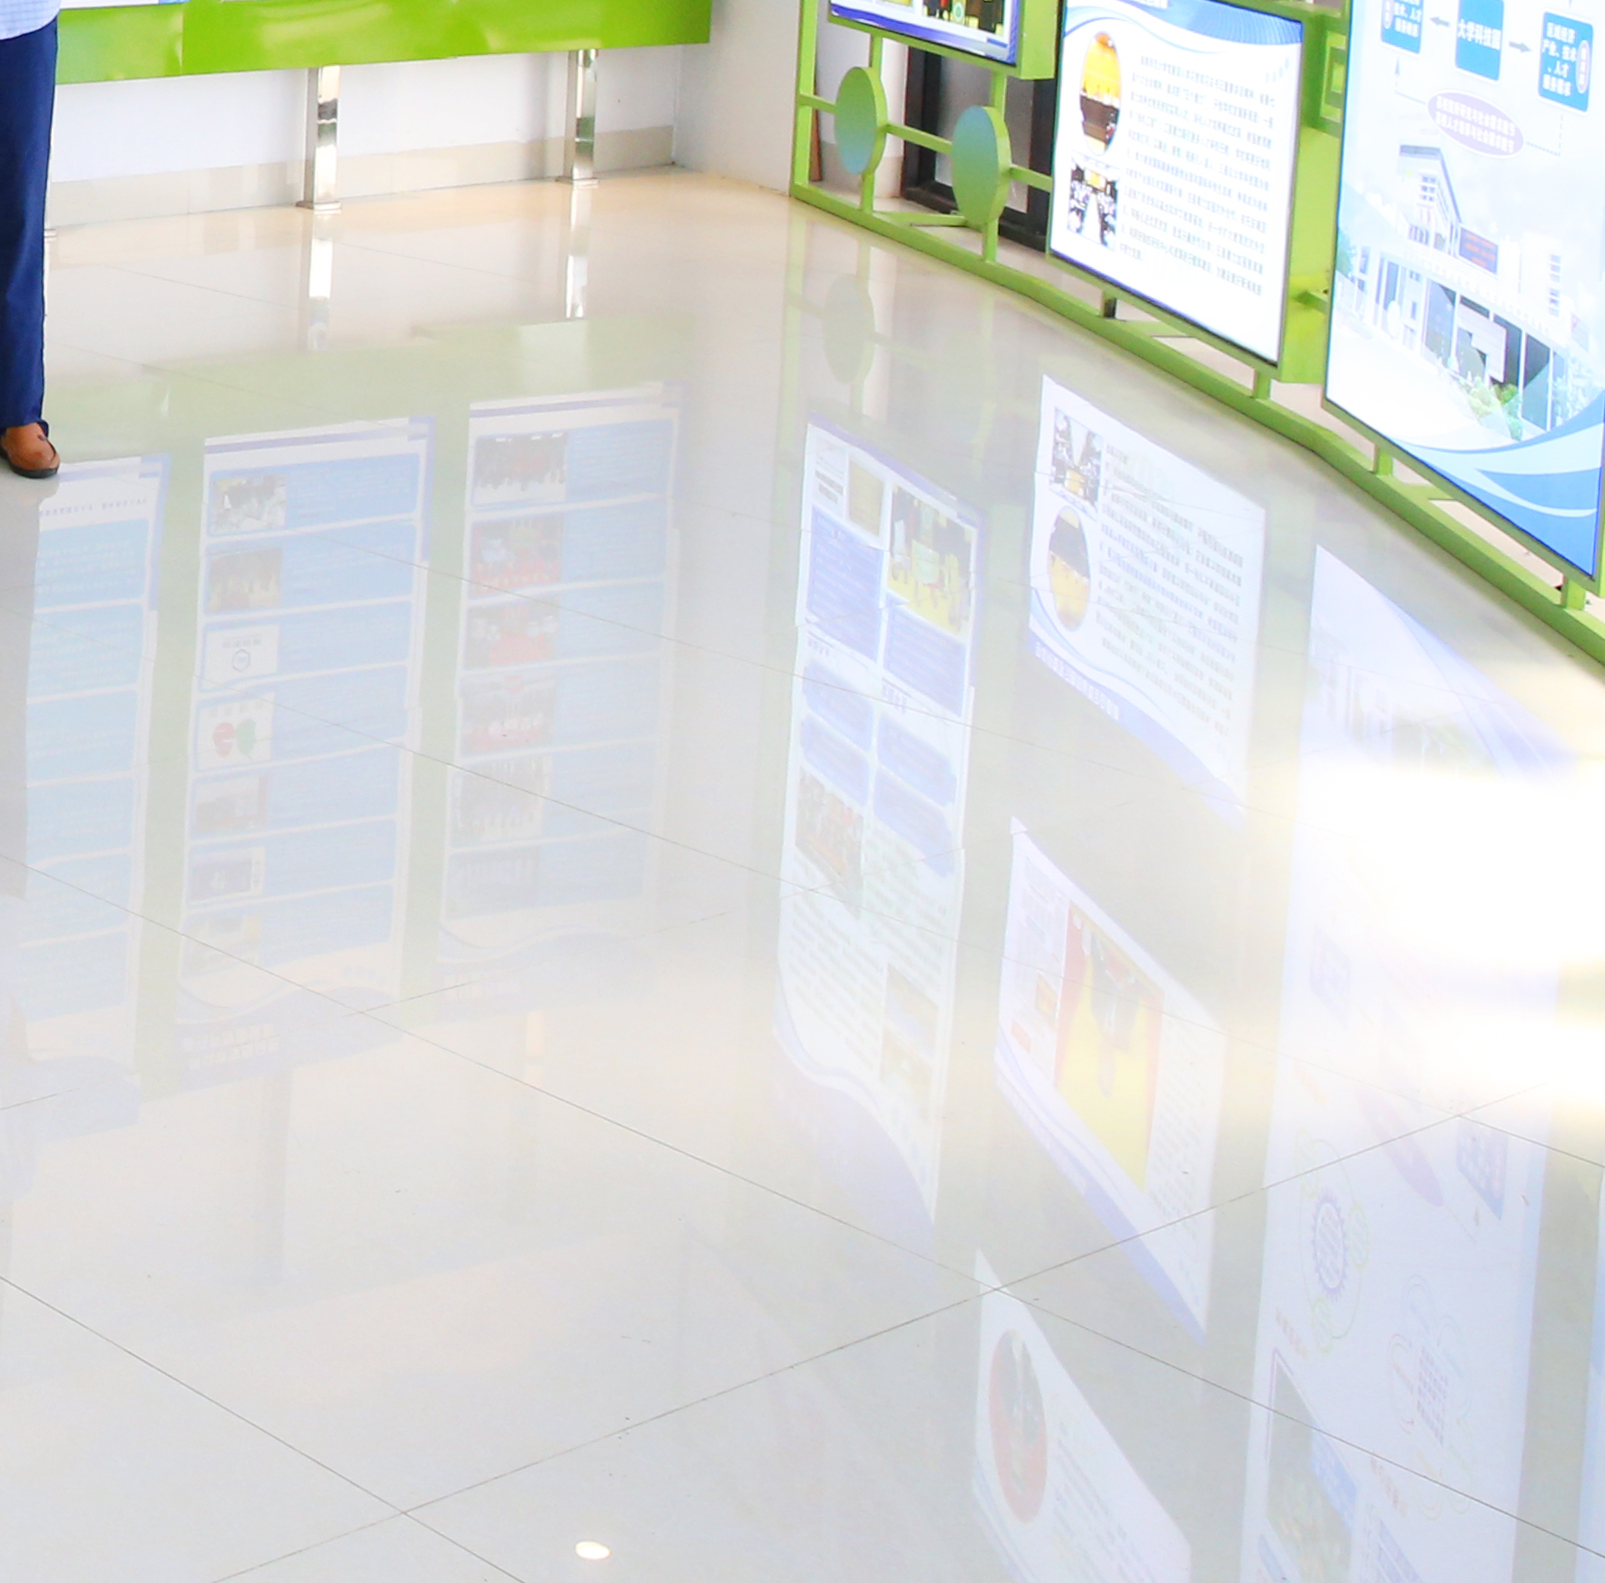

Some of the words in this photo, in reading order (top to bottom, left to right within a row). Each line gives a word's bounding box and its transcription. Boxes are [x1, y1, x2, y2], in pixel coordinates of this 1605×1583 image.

[1457, 18, 1501, 51] 大学科技园
